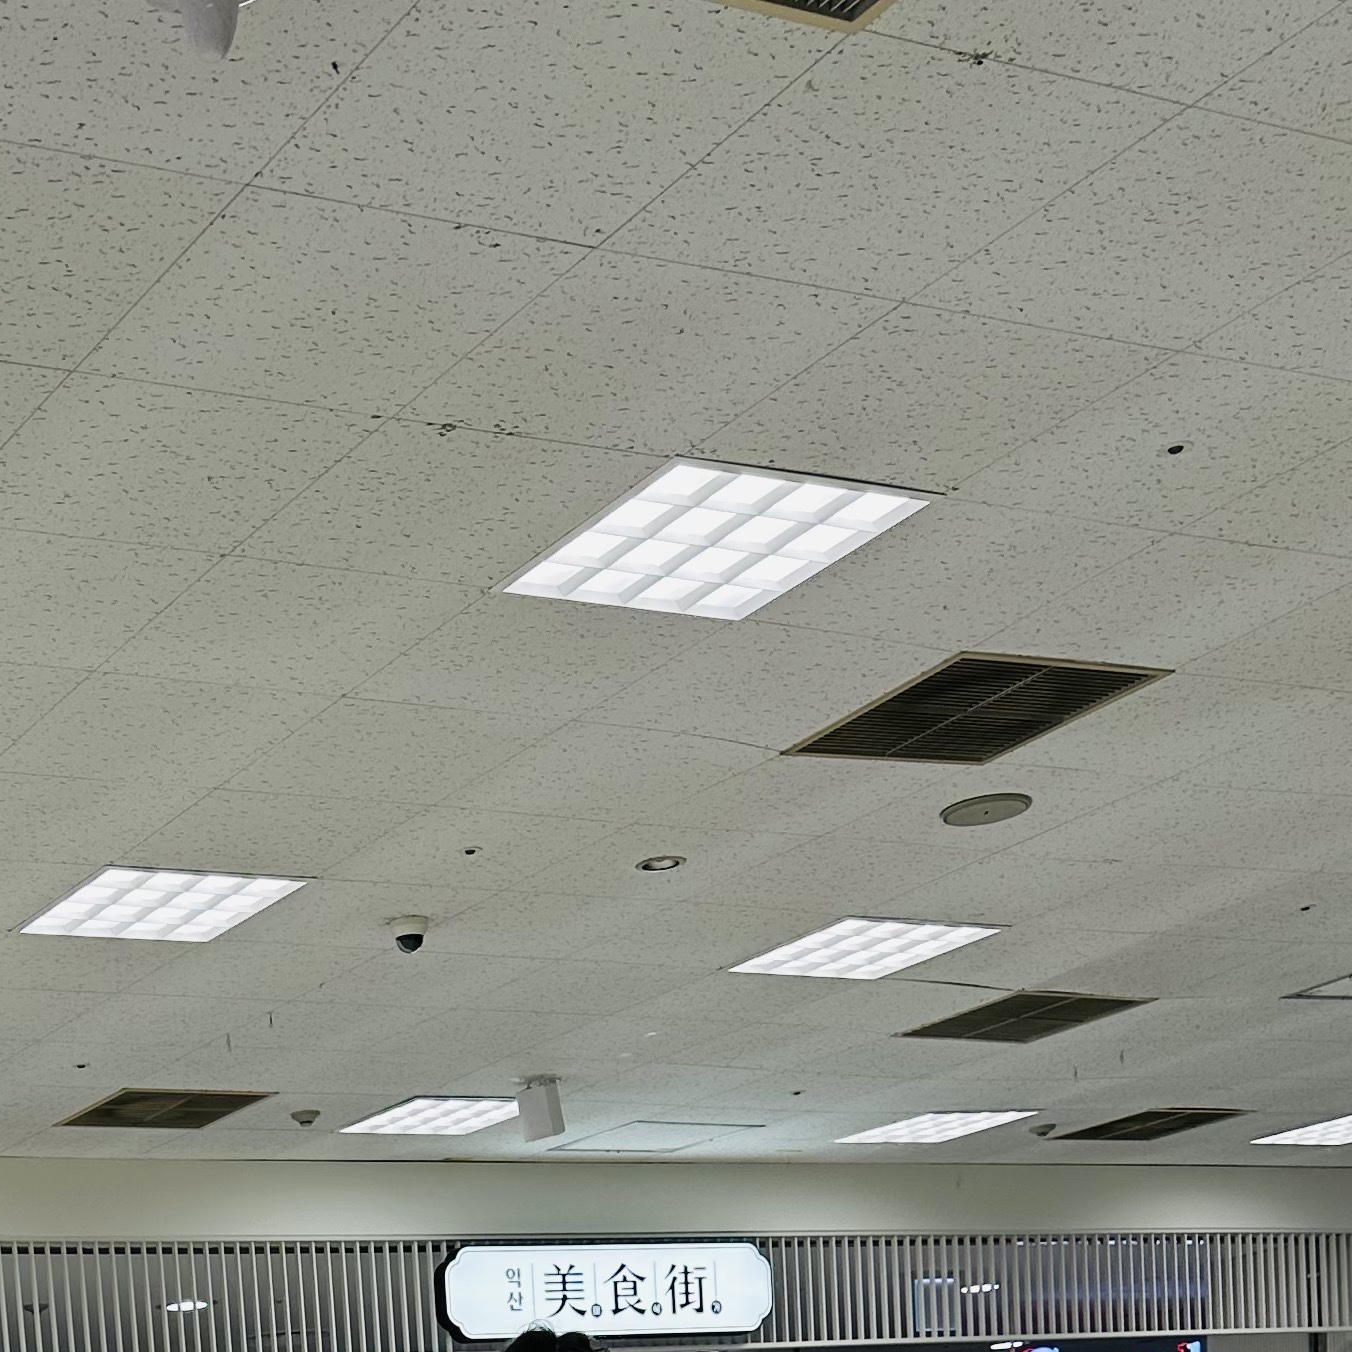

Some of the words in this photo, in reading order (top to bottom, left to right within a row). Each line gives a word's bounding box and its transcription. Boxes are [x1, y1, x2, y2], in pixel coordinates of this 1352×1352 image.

[505, 1267, 524, 1312] 익산
[544, 1262, 708, 1319] 美食街
